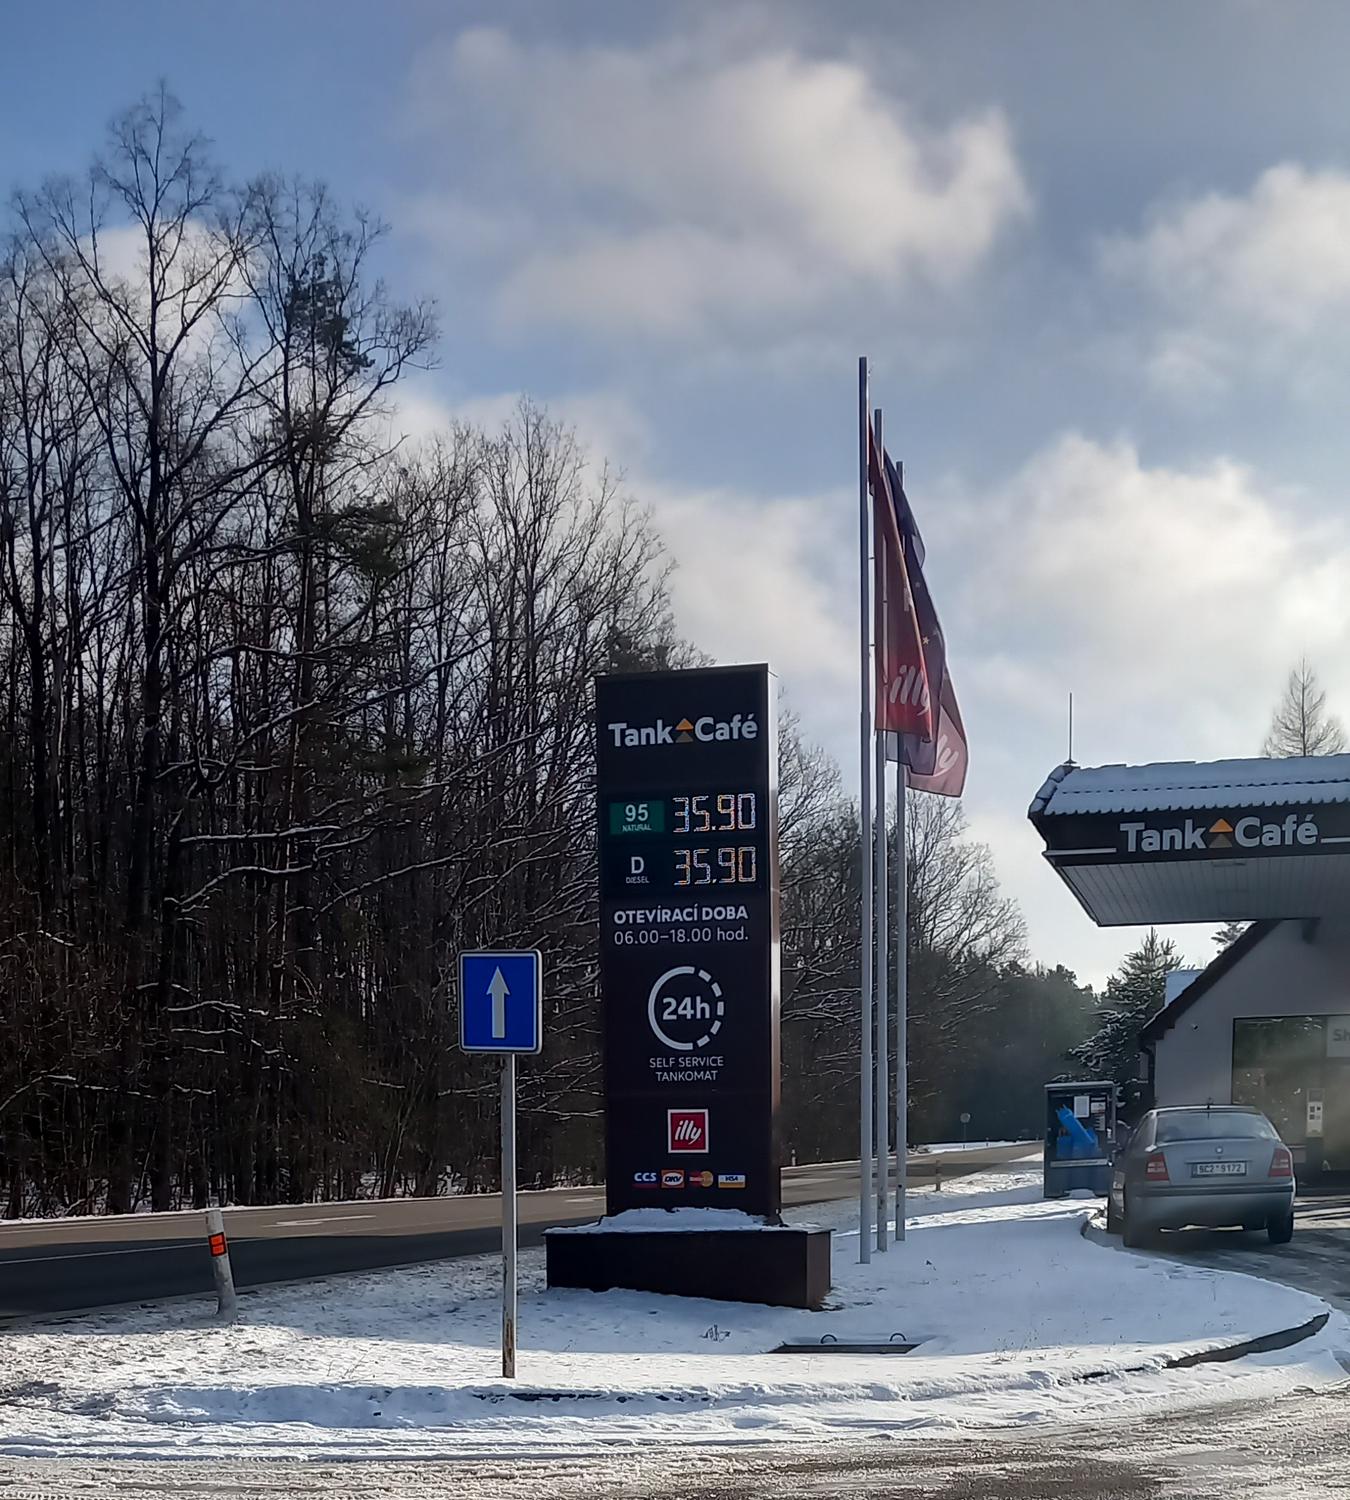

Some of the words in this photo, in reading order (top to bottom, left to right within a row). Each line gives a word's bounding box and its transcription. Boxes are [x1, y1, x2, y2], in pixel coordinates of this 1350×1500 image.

[608, 719, 674, 747] Tank
[695, 713, 758, 742] Café
[625, 804, 649, 822] 95
[622, 824, 652, 832] NATURAL
[1119, 819, 1207, 852] Tank
[1234, 814, 1319, 848] Café
[630, 856, 645, 874] D
[625, 876, 650, 884] DIESEL
[613, 903, 698, 924] OTEVÍRACÍ
[701, 905, 748, 921] DOBA
[717, 925, 749, 941] hod.
[662, 995, 711, 1021] 24h
[649, 1057, 676, 1068] SELF
[678, 1056, 724, 1067] SERVICE
[656, 1070, 718, 1082] TANKOMAT
[674, 1119, 702, 1145] illy
[634, 1172, 657, 1182] CCS
